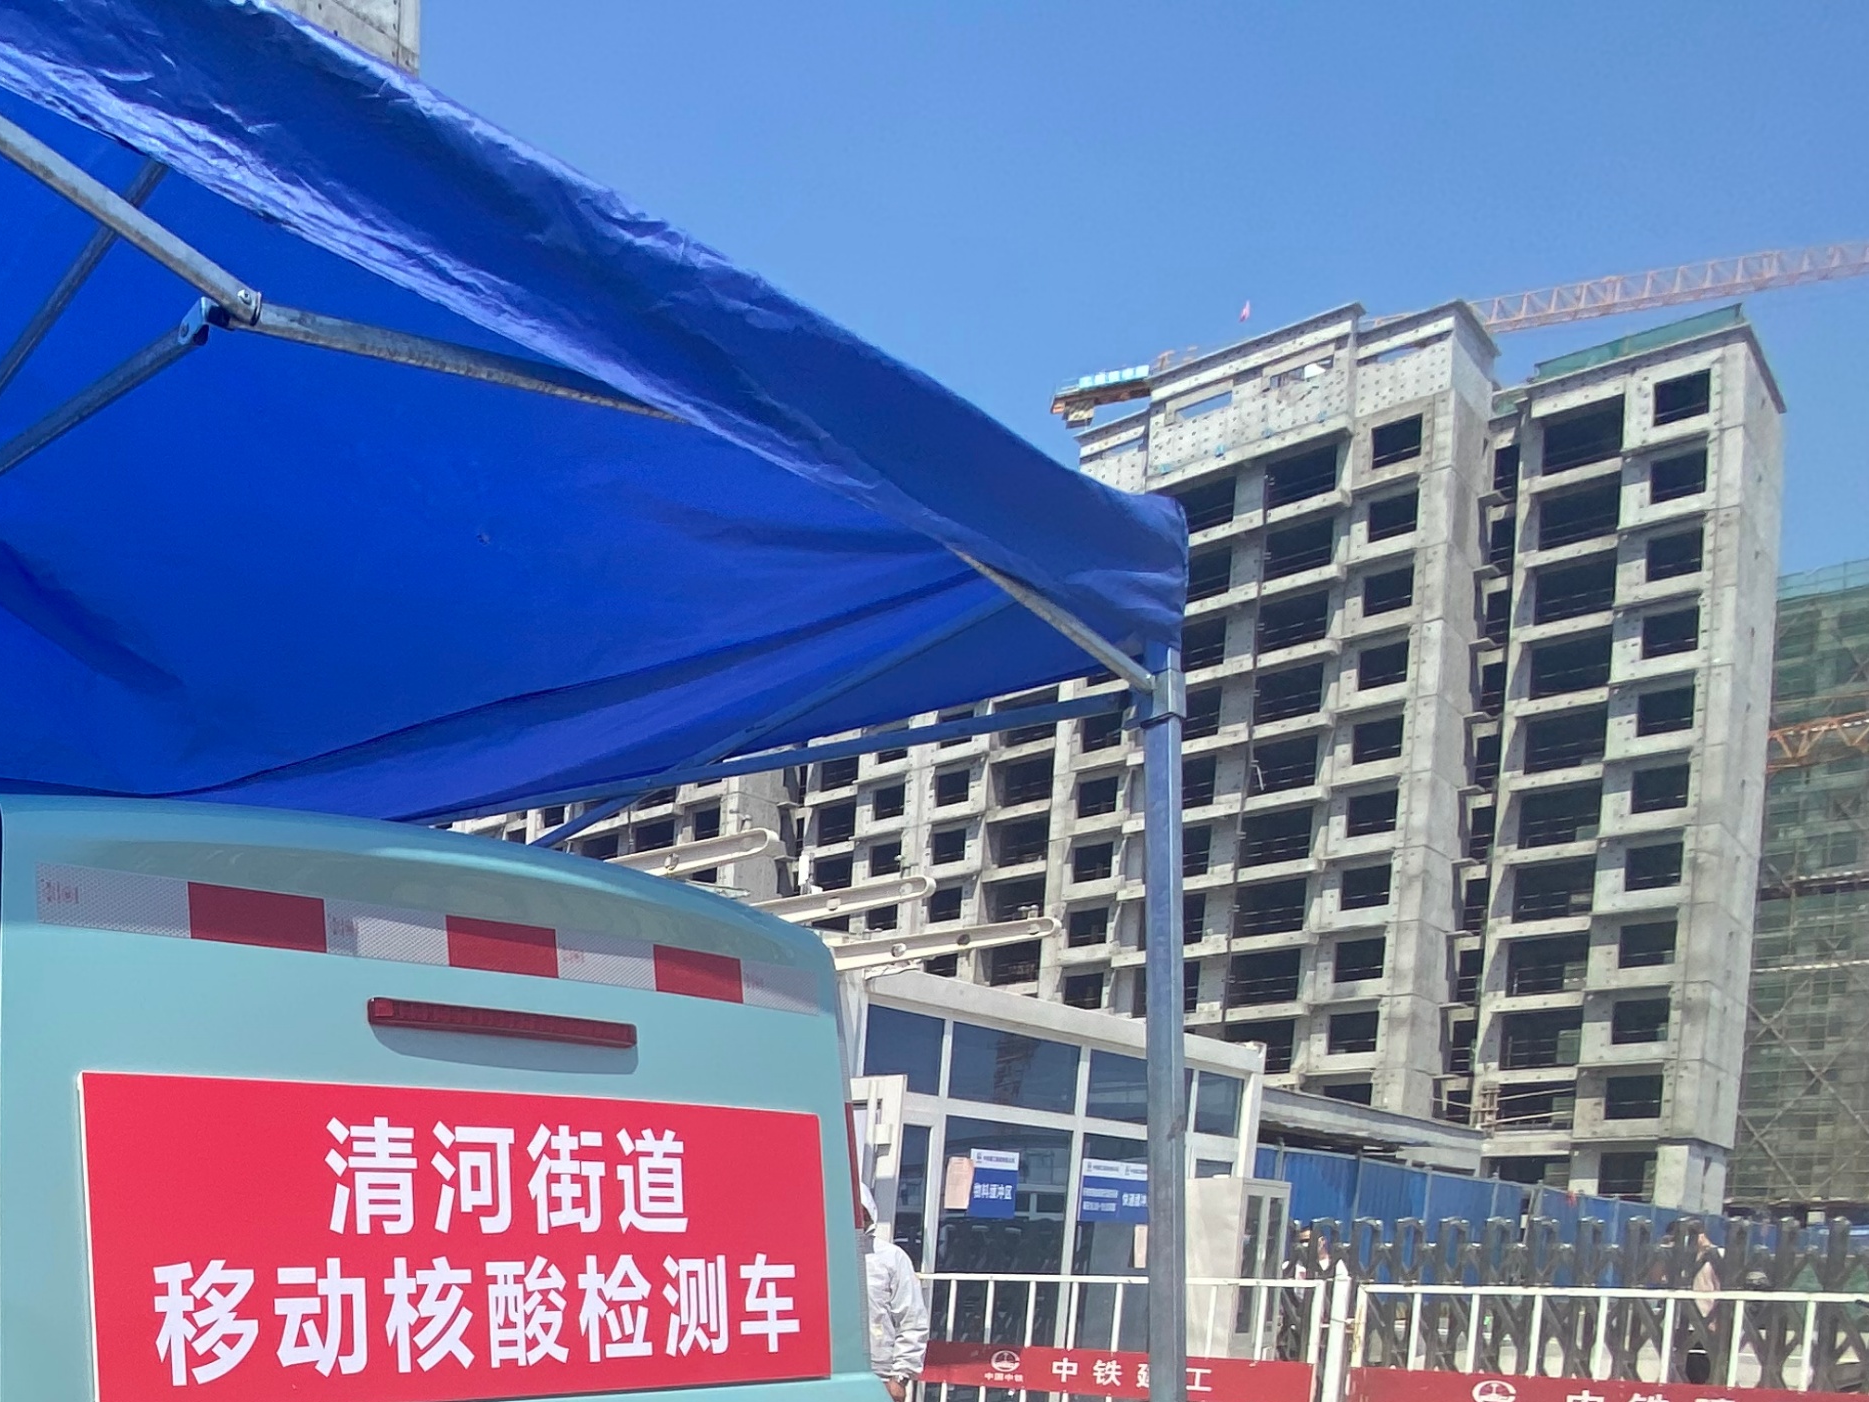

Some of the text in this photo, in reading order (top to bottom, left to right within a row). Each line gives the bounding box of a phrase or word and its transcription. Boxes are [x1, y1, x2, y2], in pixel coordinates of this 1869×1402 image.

[325, 1116, 690, 1236] 清河街道
[153, 1253, 801, 1388] 移动核酸检测车
